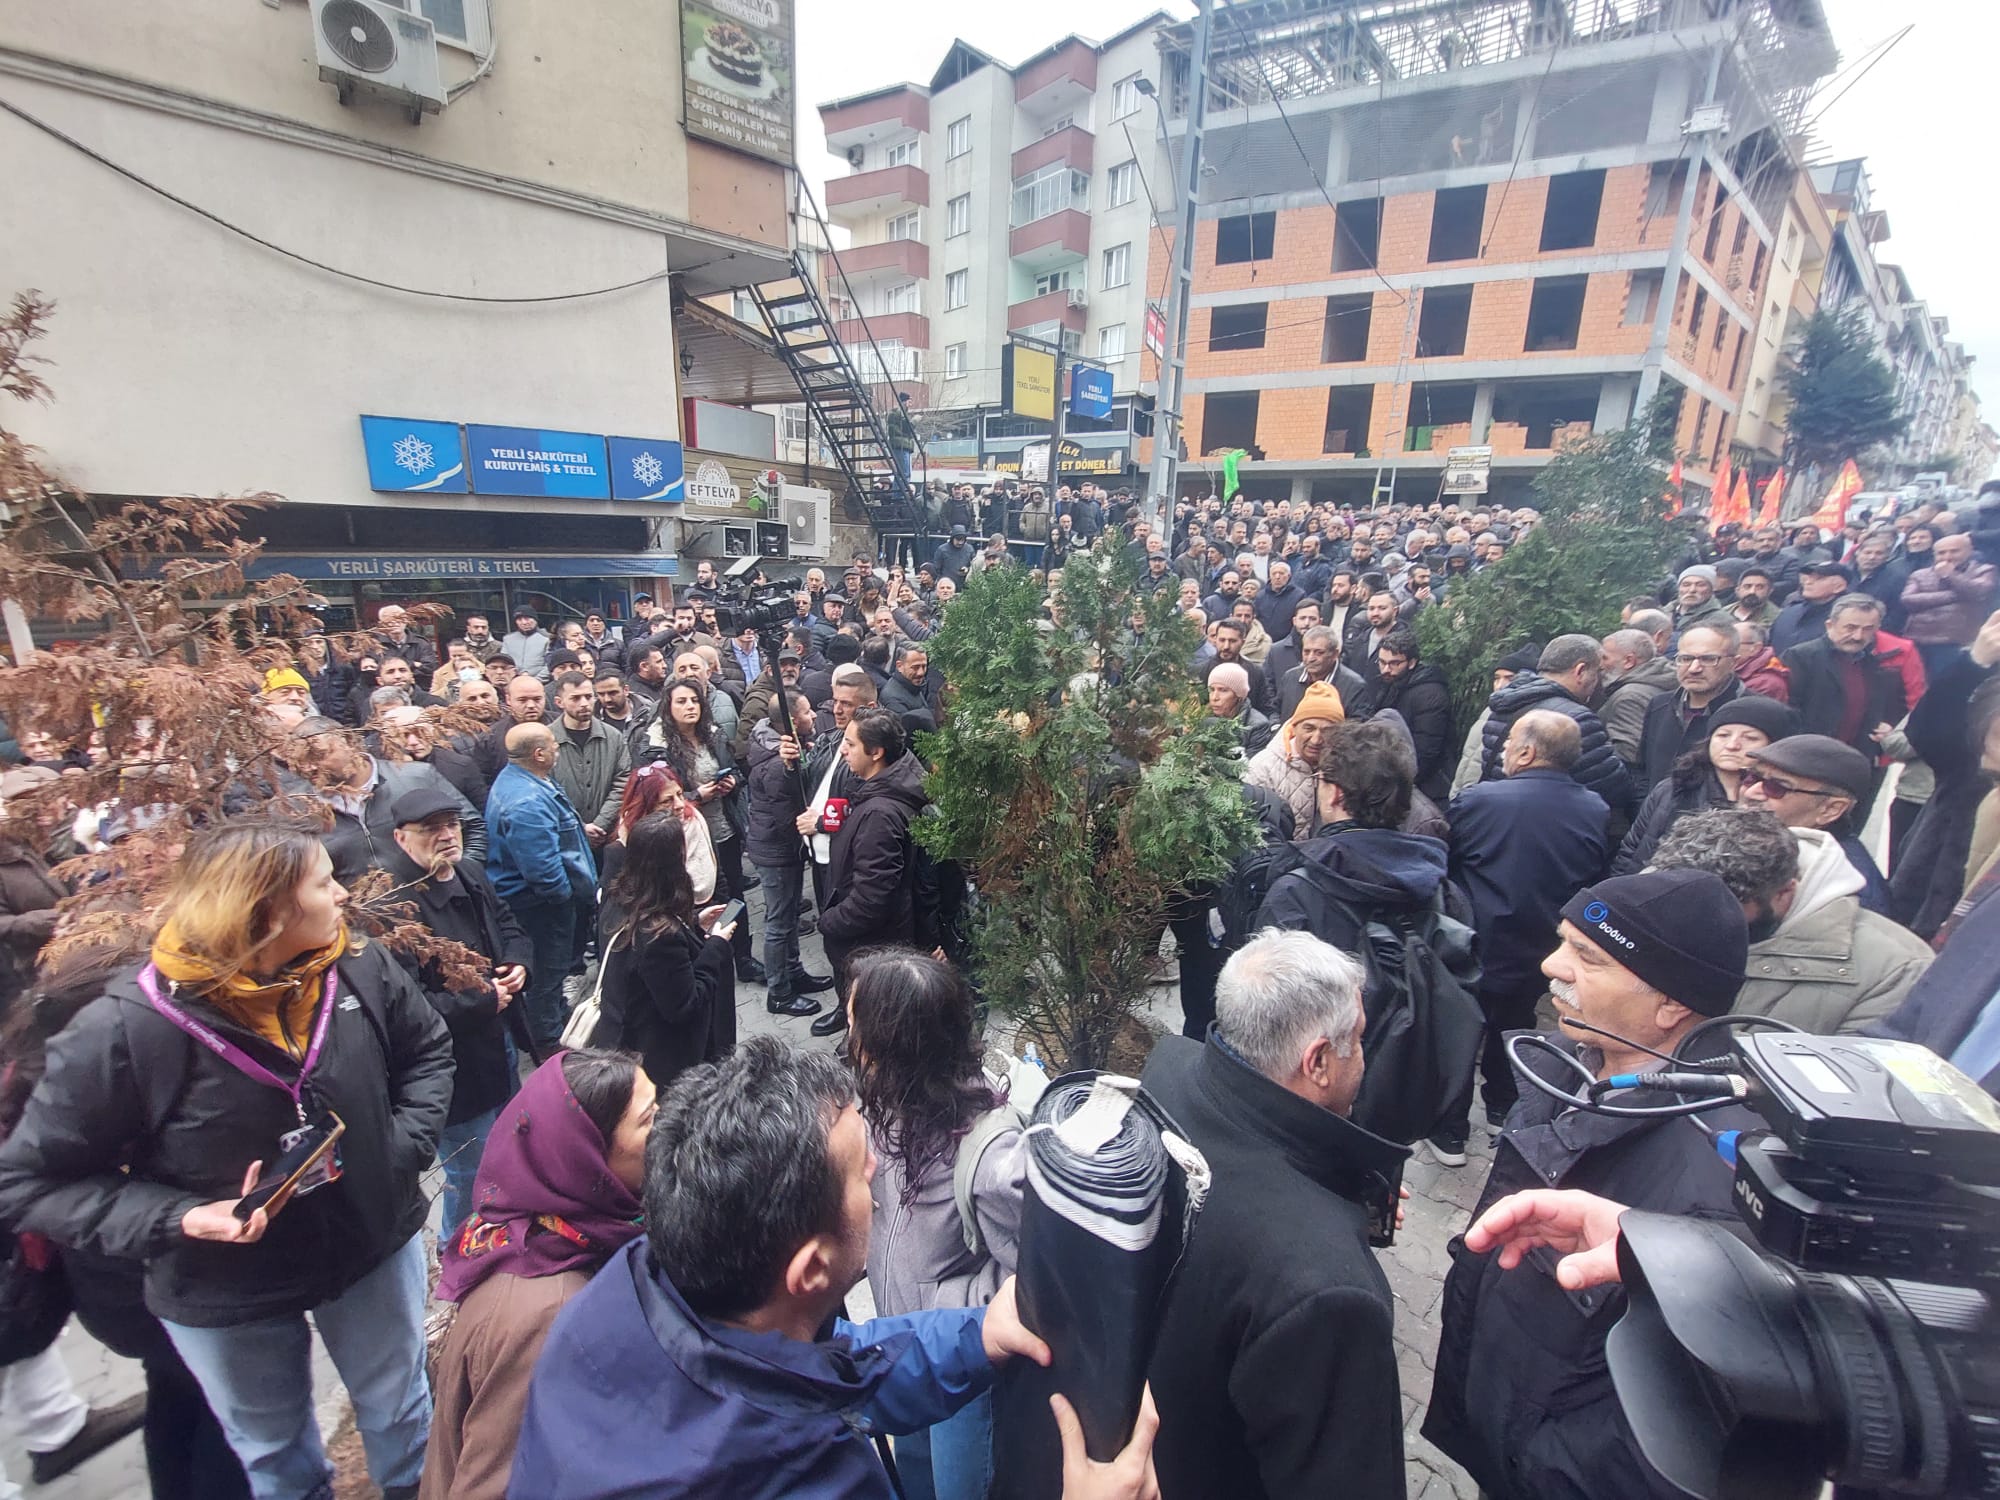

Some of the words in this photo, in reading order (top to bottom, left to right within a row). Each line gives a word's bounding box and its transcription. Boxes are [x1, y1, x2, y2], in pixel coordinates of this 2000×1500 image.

[697, 84, 738, 109] DÜĞÜN
[691, 98, 719, 117] ÖZEL
[722, 110, 764, 133] GÜNLER
[702, 116, 743, 142] SİPARİŞ
[745, 133, 778, 152] ALINIR
[491, 448, 526, 460] YERLİ
[527, 451, 588, 464] ŞARKÜTERİ
[1061, 461, 1074, 471] ET
[1075, 458, 1105, 470] DÖNER
[484, 460, 551, 475] KURUYEMİŞ
[552, 464, 561, 473] &
[563, 464, 597, 476] TEKEL
[996, 463, 1019, 472] ODUN
[690, 484, 736, 499] EFTELYA
[328, 558, 379, 574] YERLİ
[382, 558, 473, 577] ŞARKÜTERİ
[478, 561, 490, 573] &
[493, 560, 540, 573] TEKEL
[1599, 921, 1627, 944] DOĞUŞ
[1736, 1179, 1763, 1220] JVC
